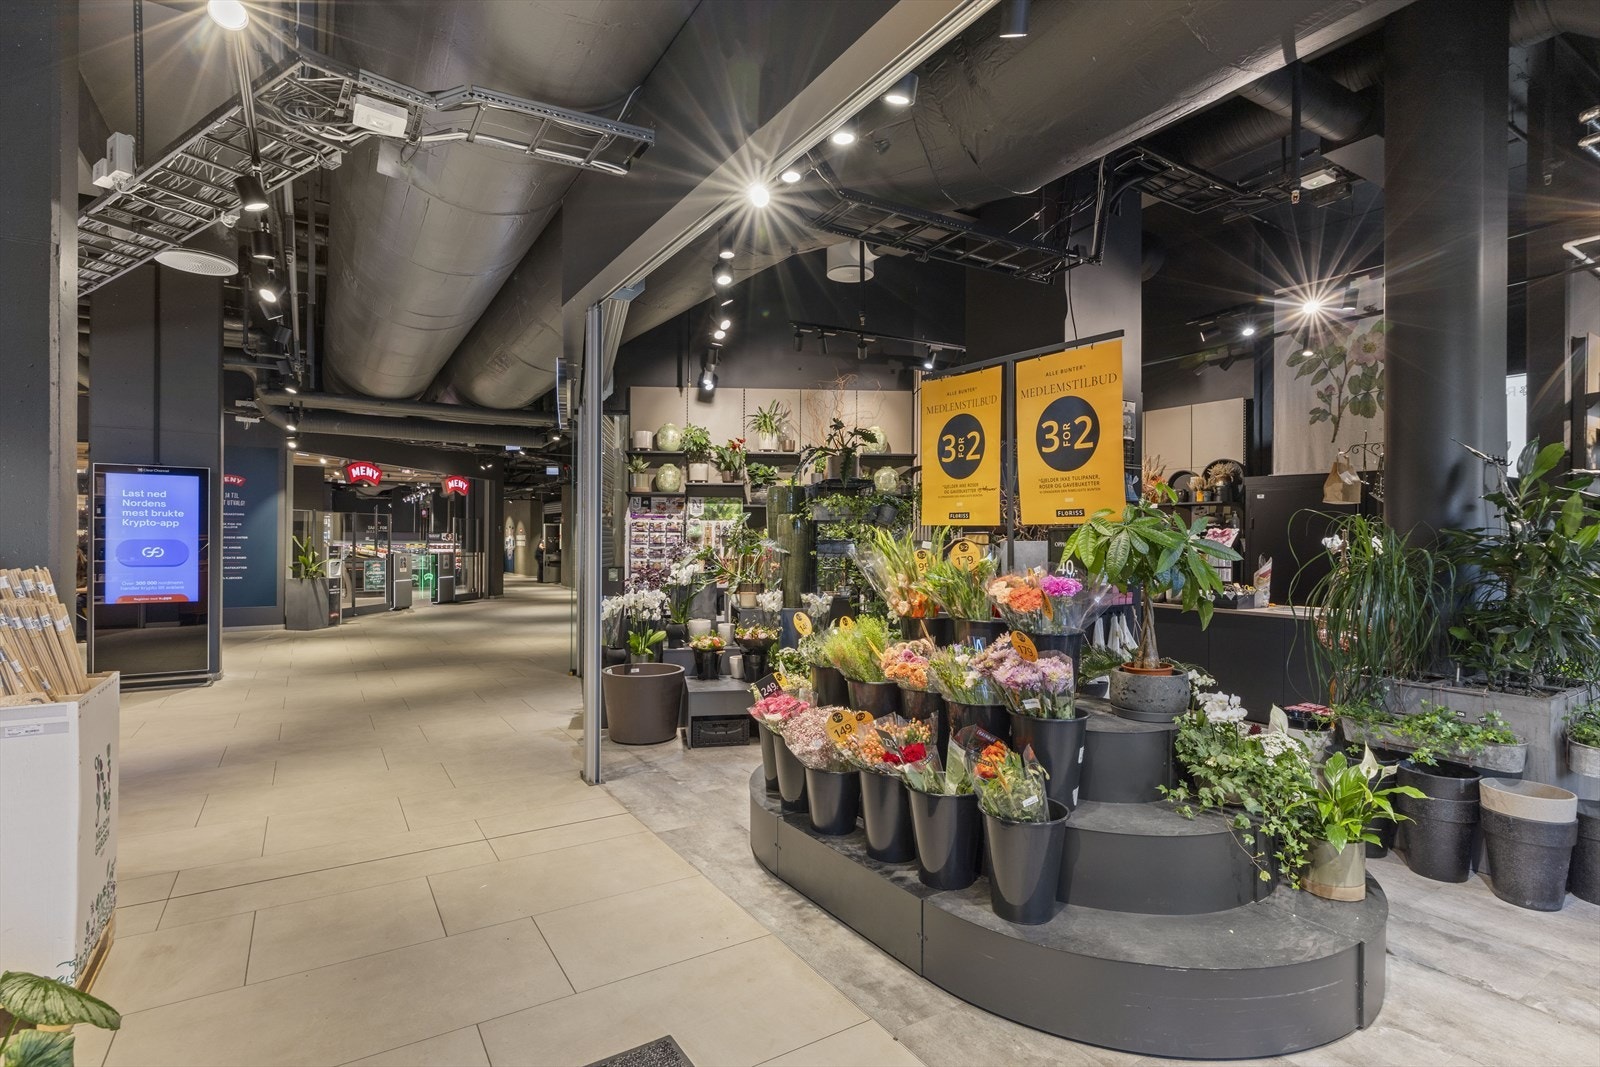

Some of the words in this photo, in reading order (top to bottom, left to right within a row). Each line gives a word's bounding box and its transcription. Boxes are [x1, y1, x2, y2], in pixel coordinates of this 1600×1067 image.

[1045, 369, 1058, 377] ALLE
[1020, 373, 1118, 399] MEDLEMSTILBUD
[926, 395, 998, 414] MEDLEMSTILBUD
[1041, 420, 1060, 453] 3
[1062, 422, 1071, 447] FOR
[1073, 415, 1094, 450] 2
[941, 434, 956, 463] 3
[957, 437, 965, 458] FOR
[965, 431, 981, 460] 2
[351, 466, 380, 480] MENY
[224, 476, 243, 484] ENY
[447, 479, 468, 490] MENY
[122, 489, 145, 498] Last
[147, 490, 167, 498] ned
[122, 499, 167, 508] Nordens
[151, 510, 184, 518] brukte
[122, 519, 180, 528] Krypto-app
